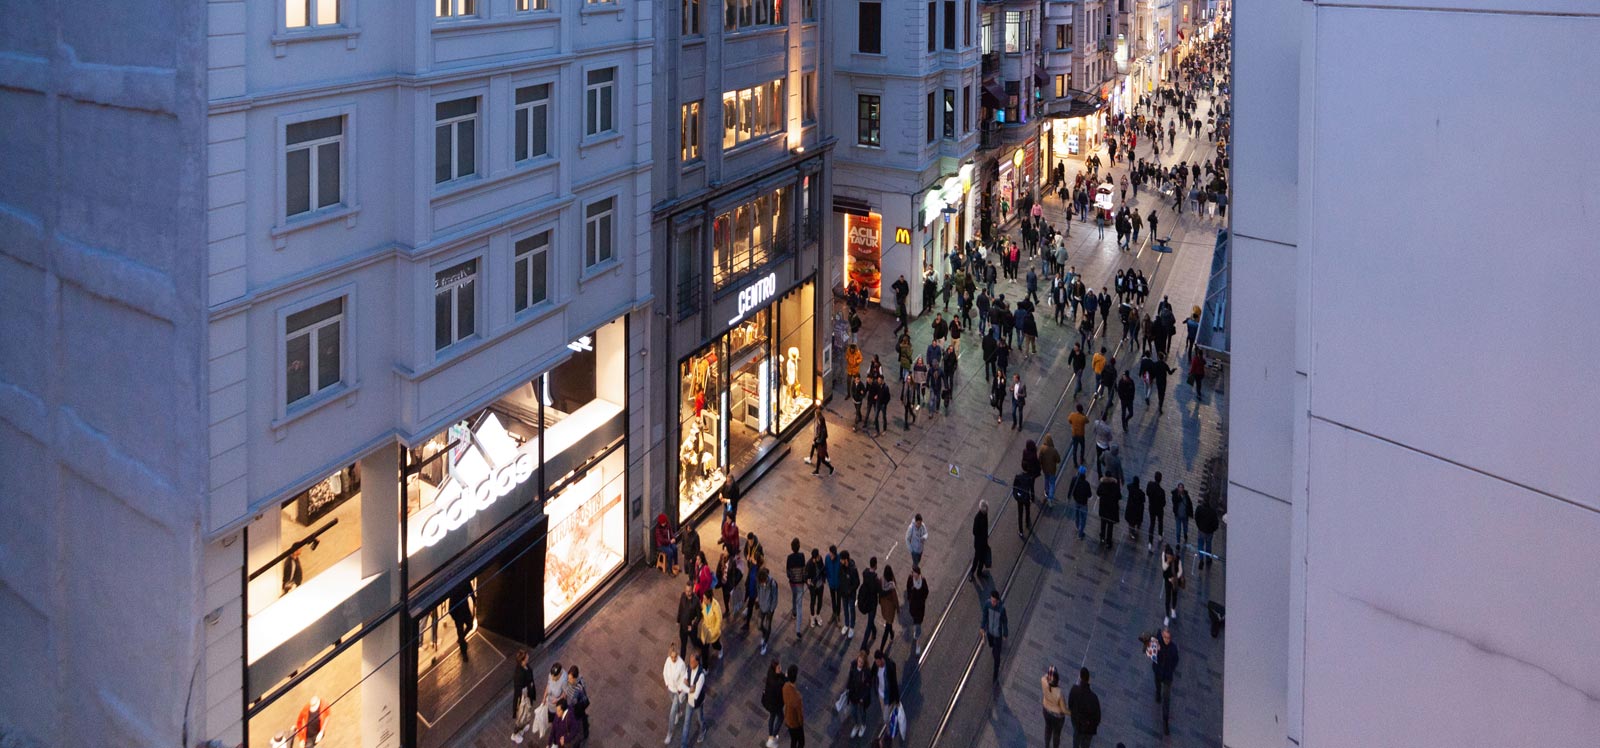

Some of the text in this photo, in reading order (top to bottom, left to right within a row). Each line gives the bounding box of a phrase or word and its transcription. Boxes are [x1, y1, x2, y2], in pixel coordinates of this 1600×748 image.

[849, 225, 879, 240] ACILI
[850, 235, 879, 248] TAVUK
[728, 272, 776, 325] CENTRO
[420, 452, 533, 547] adidas
